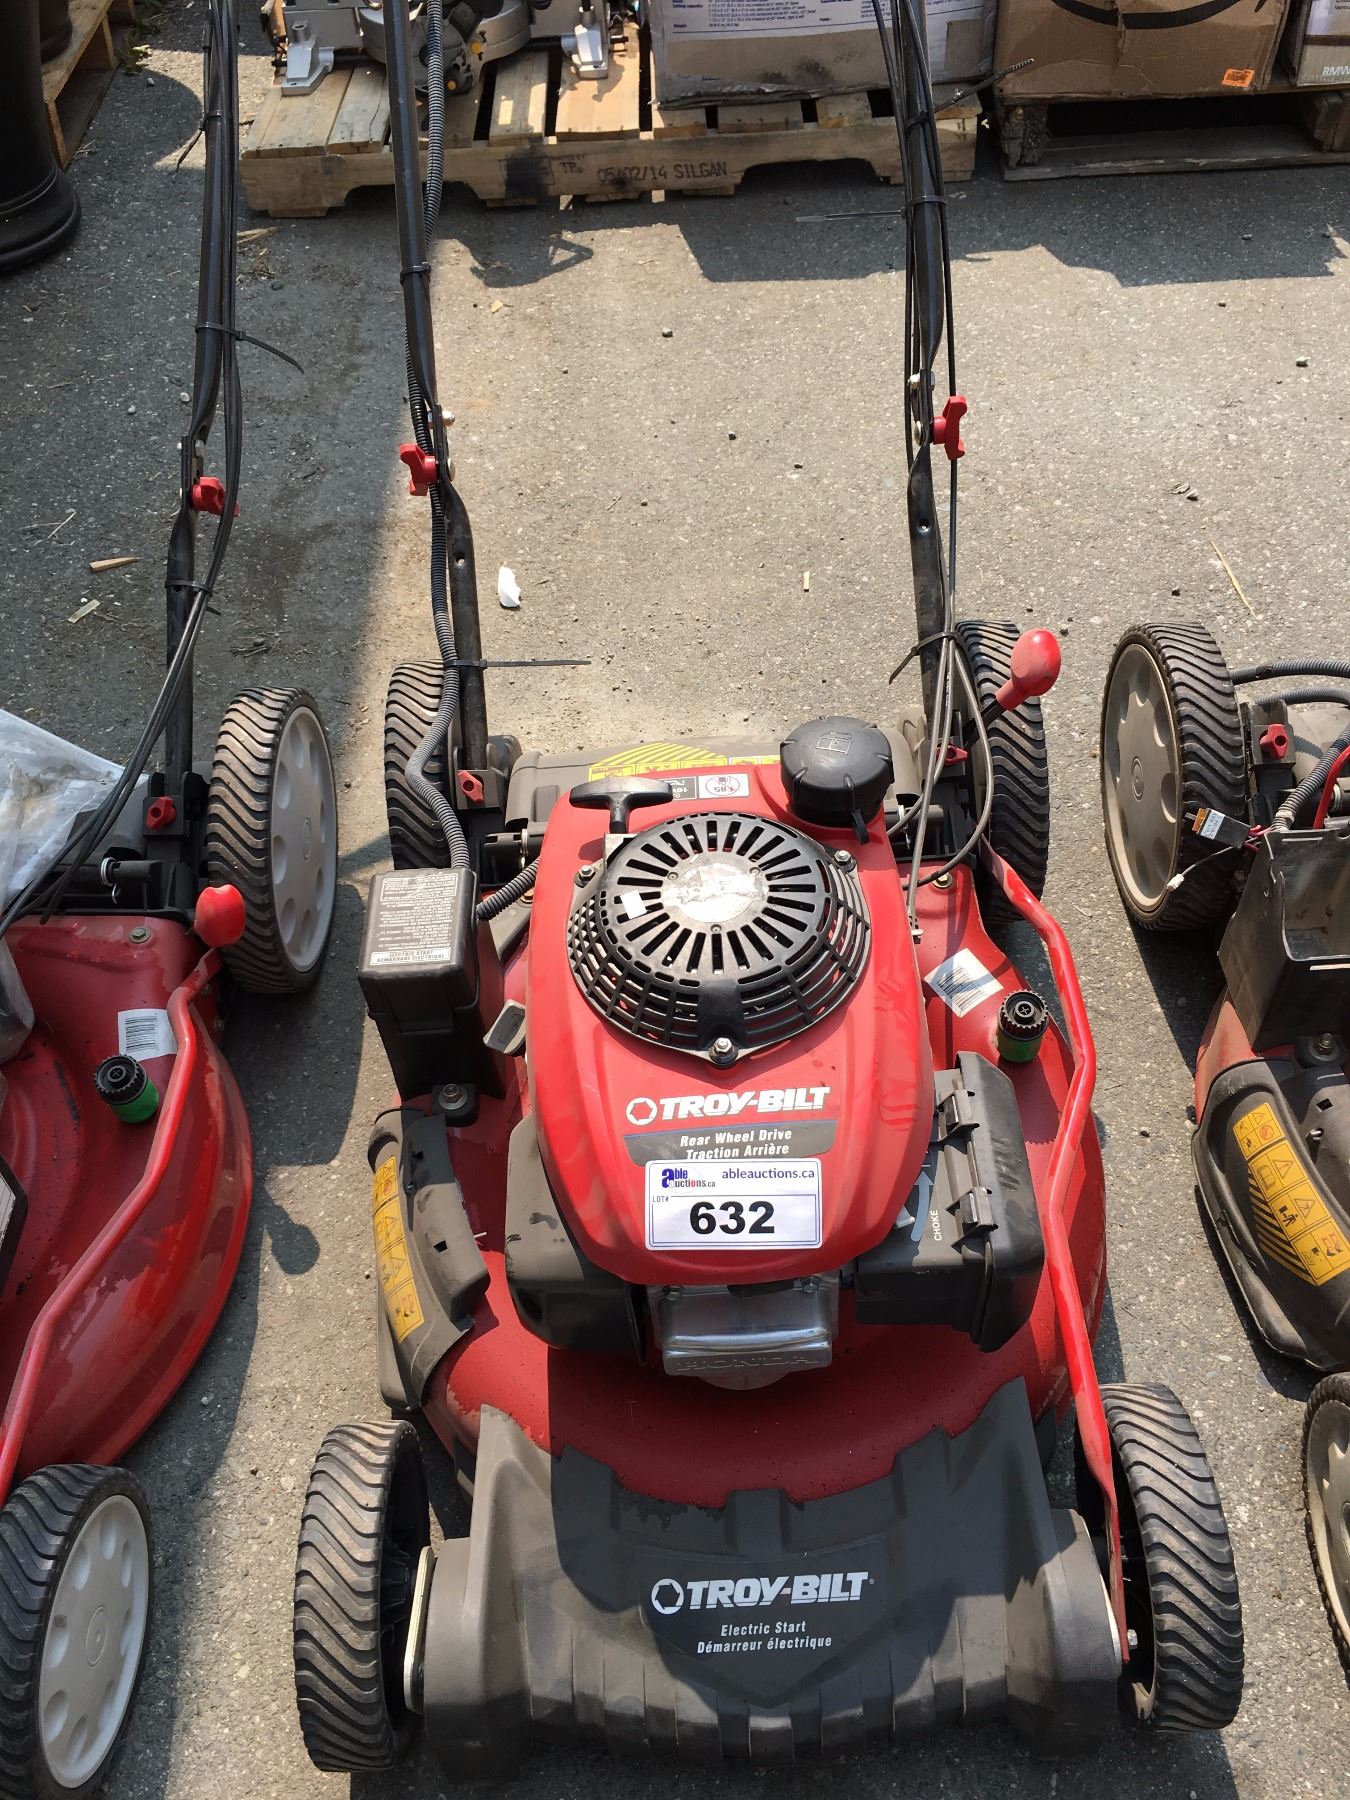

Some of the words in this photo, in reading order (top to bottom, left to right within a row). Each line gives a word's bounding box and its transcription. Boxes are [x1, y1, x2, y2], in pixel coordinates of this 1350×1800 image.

[674, 161, 728, 179] SILGAN
[660, 1086, 831, 1121] TROY-BILT
[680, 1134, 710, 1147] Rear
[714, 1130, 754, 1144] Wheel
[759, 1128, 792, 1141] Drive
[686, 1143, 739, 1160] Traction
[743, 1143, 789, 1157] Arrière
[721, 1167, 815, 1179] ableauctions.ca
[689, 1201, 775, 1235] 632
[929, 1209, 943, 1242] CHOKE
[720, 1622, 770, 1637] Electric
[774, 1620, 806, 1634] Start
[697, 1637, 762, 1654] Démarreur
[767, 1635, 833, 1651] électrique
